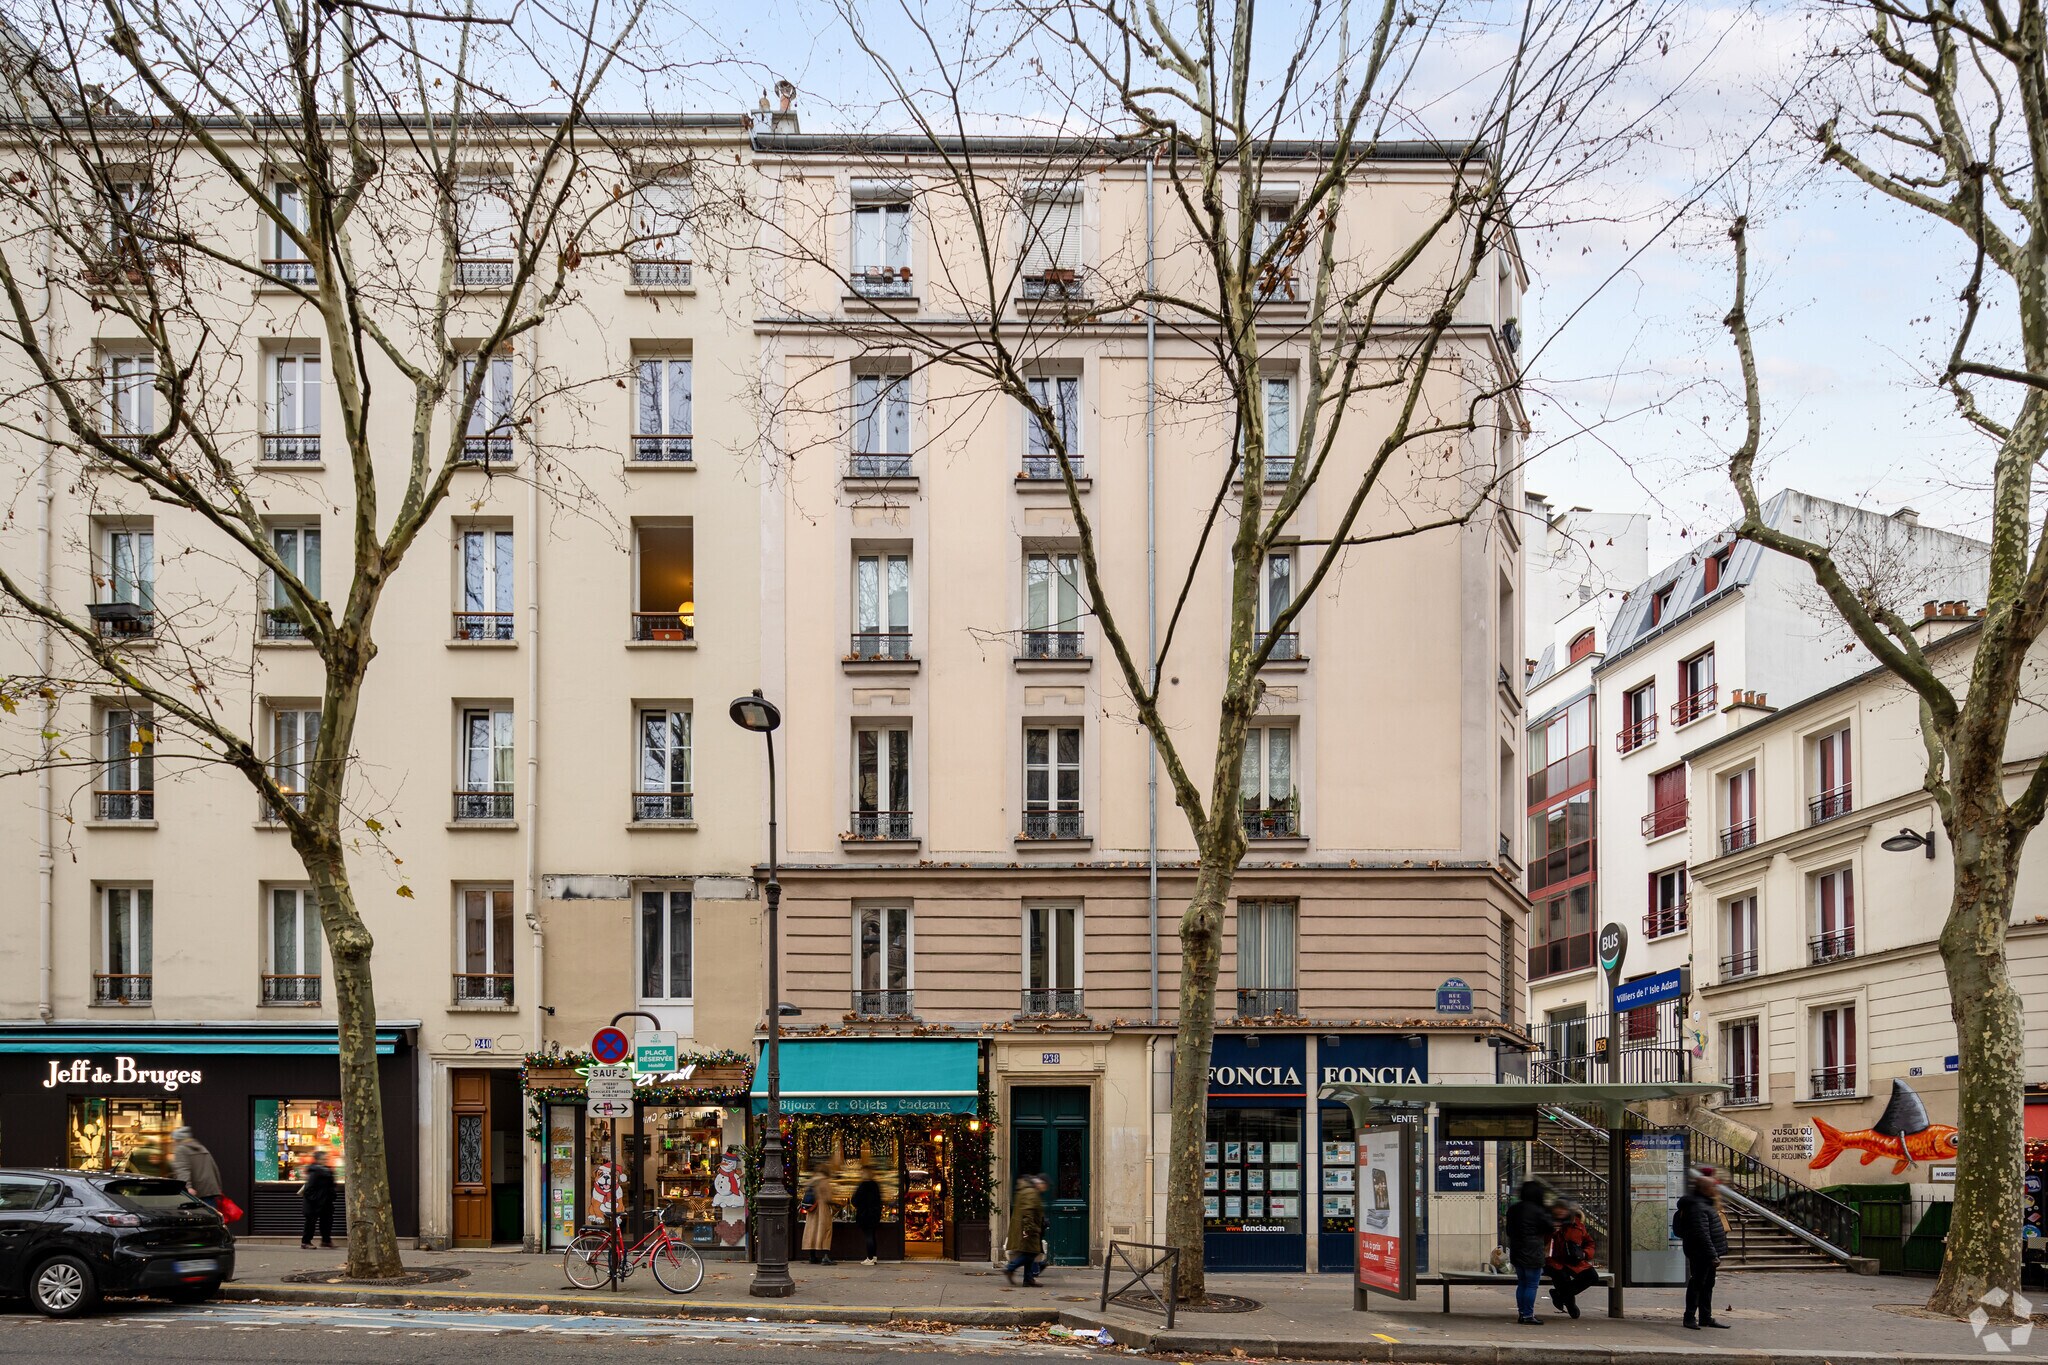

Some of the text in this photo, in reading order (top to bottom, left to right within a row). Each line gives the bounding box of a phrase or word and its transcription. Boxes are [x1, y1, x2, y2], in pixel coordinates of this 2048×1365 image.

[1602, 932, 1619, 951] BUS
[1616, 992, 1636, 1004] Villiers
[1636, 989, 1644, 997] de
[1649, 984, 1660, 995] Isle
[1660, 980, 1679, 992] Adam
[475, 1039, 491, 1049] 240
[1597, 1040, 1606, 1051] 26
[639, 1054, 673, 1062] RÉSERVÉE
[1043, 1053, 1060, 1064] 238
[43, 1056, 202, 1092] Jeff de Bruges
[593, 1069, 617, 1077] SAUF
[1208, 1066, 1302, 1086] FONCIA
[1323, 1066, 1423, 1084] FONCIA
[1911, 1067, 1922, 1076] 62
[779, 1099, 950, 1111] Bijoux et Objets Cadeaux
[1391, 1115, 1418, 1123] VENTE
[1226, 1224, 1285, 1232] www.foncia.com
